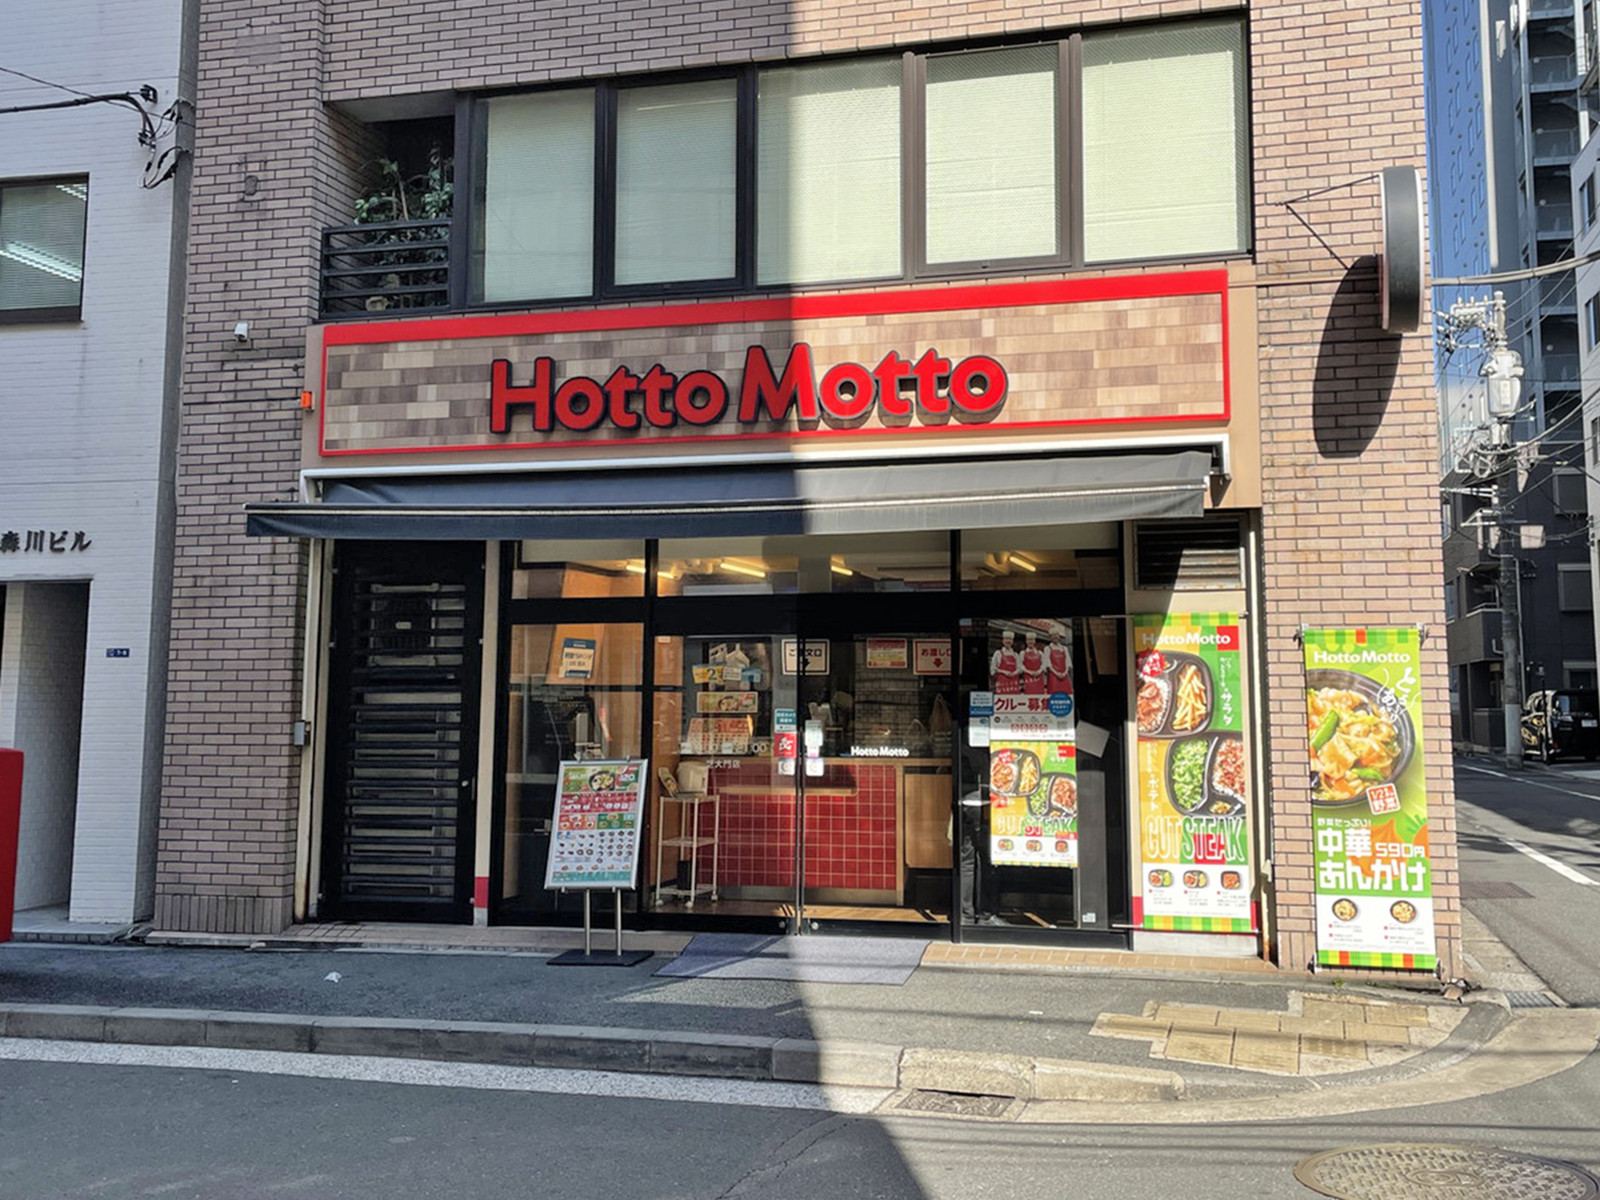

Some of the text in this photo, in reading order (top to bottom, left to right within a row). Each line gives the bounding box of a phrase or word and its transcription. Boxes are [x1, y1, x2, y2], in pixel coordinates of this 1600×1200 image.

[490, 342, 1008, 434] Hotto Motto
[0, 530, 92, 552] 森川ビル
[1142, 632, 1231, 645] Hotto Motto
[1314, 650, 1411, 663] Hotto Motto
[851, 746, 910, 757] Hotto Motto
[1145, 816, 1245, 862] CUT STEAK
[1317, 827, 1372, 858] 中華
[1375, 843, 1425, 858] 590円
[1319, 859, 1426, 892] あんかけ
